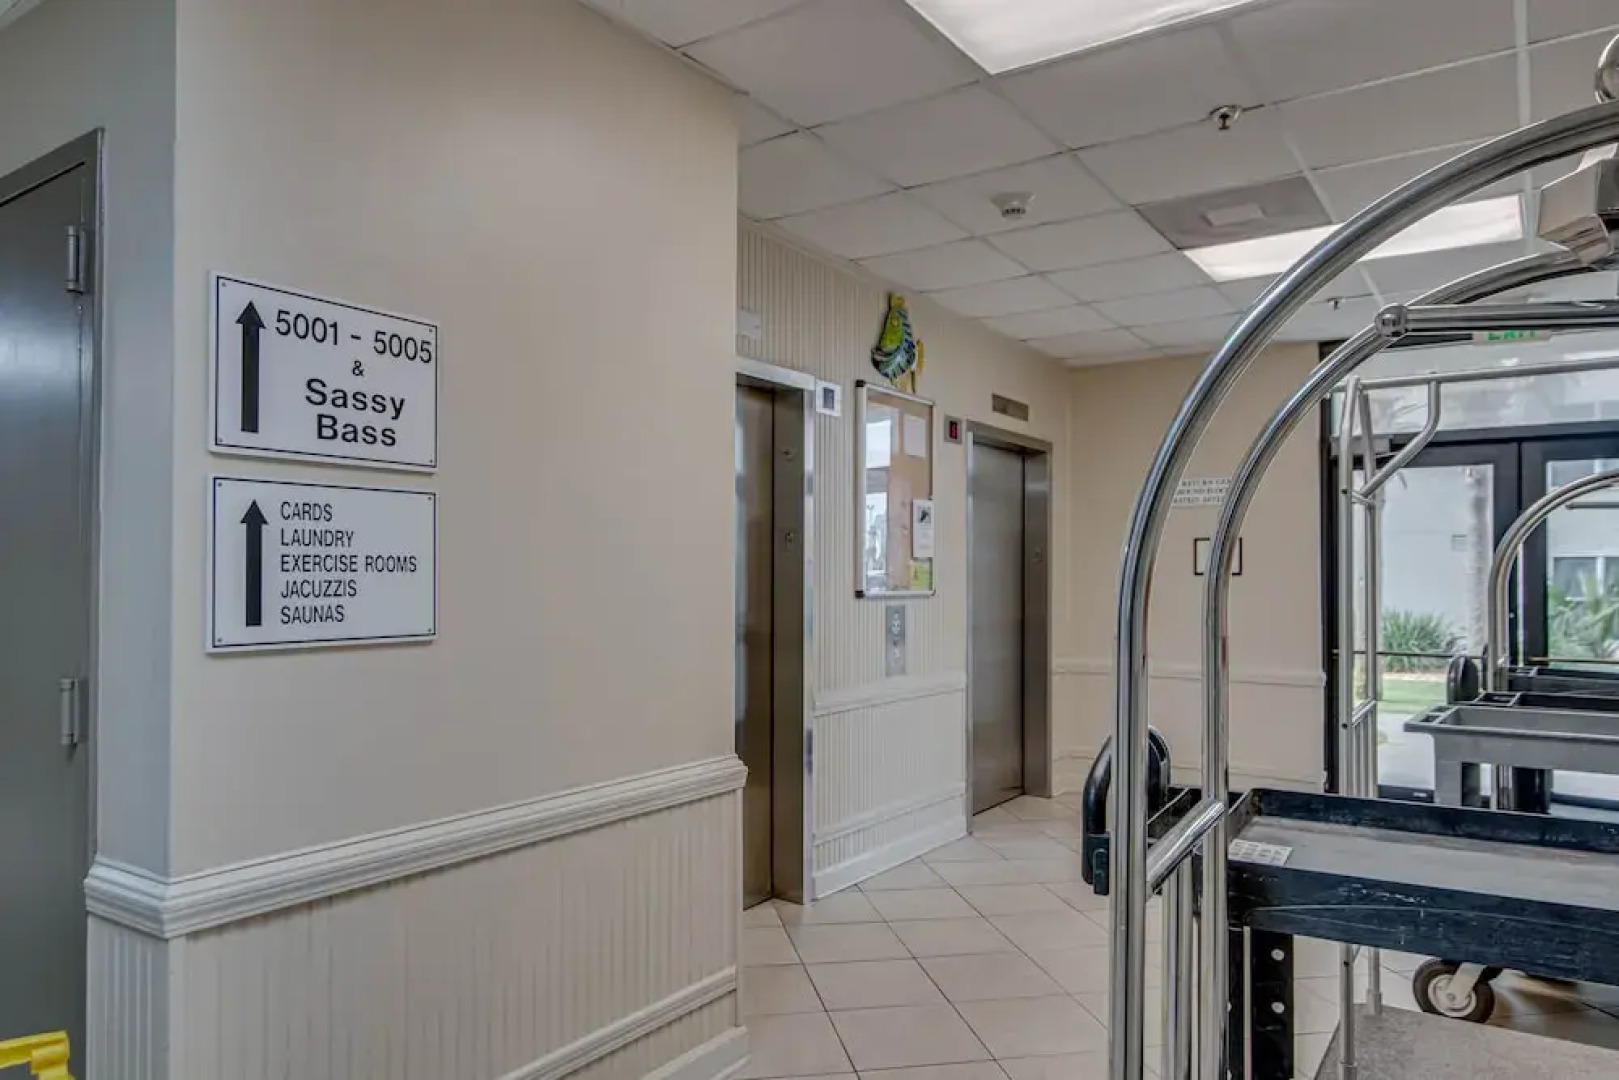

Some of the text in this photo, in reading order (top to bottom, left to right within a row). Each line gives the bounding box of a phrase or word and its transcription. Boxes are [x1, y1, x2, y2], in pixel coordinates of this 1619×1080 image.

[275, 309, 432, 364] 5001 - 5005
[352, 360, 365, 377] &
[305, 378, 406, 420] Sassy
[316, 414, 396, 447] Bass
[280, 501, 333, 522] CARDS
[280, 528, 355, 548] LAUNDRY
[280, 554, 417, 573] EXERCISE ROOMS
[280, 579, 358, 599] JACUZZIS
[280, 604, 346, 625] SAUNAS
